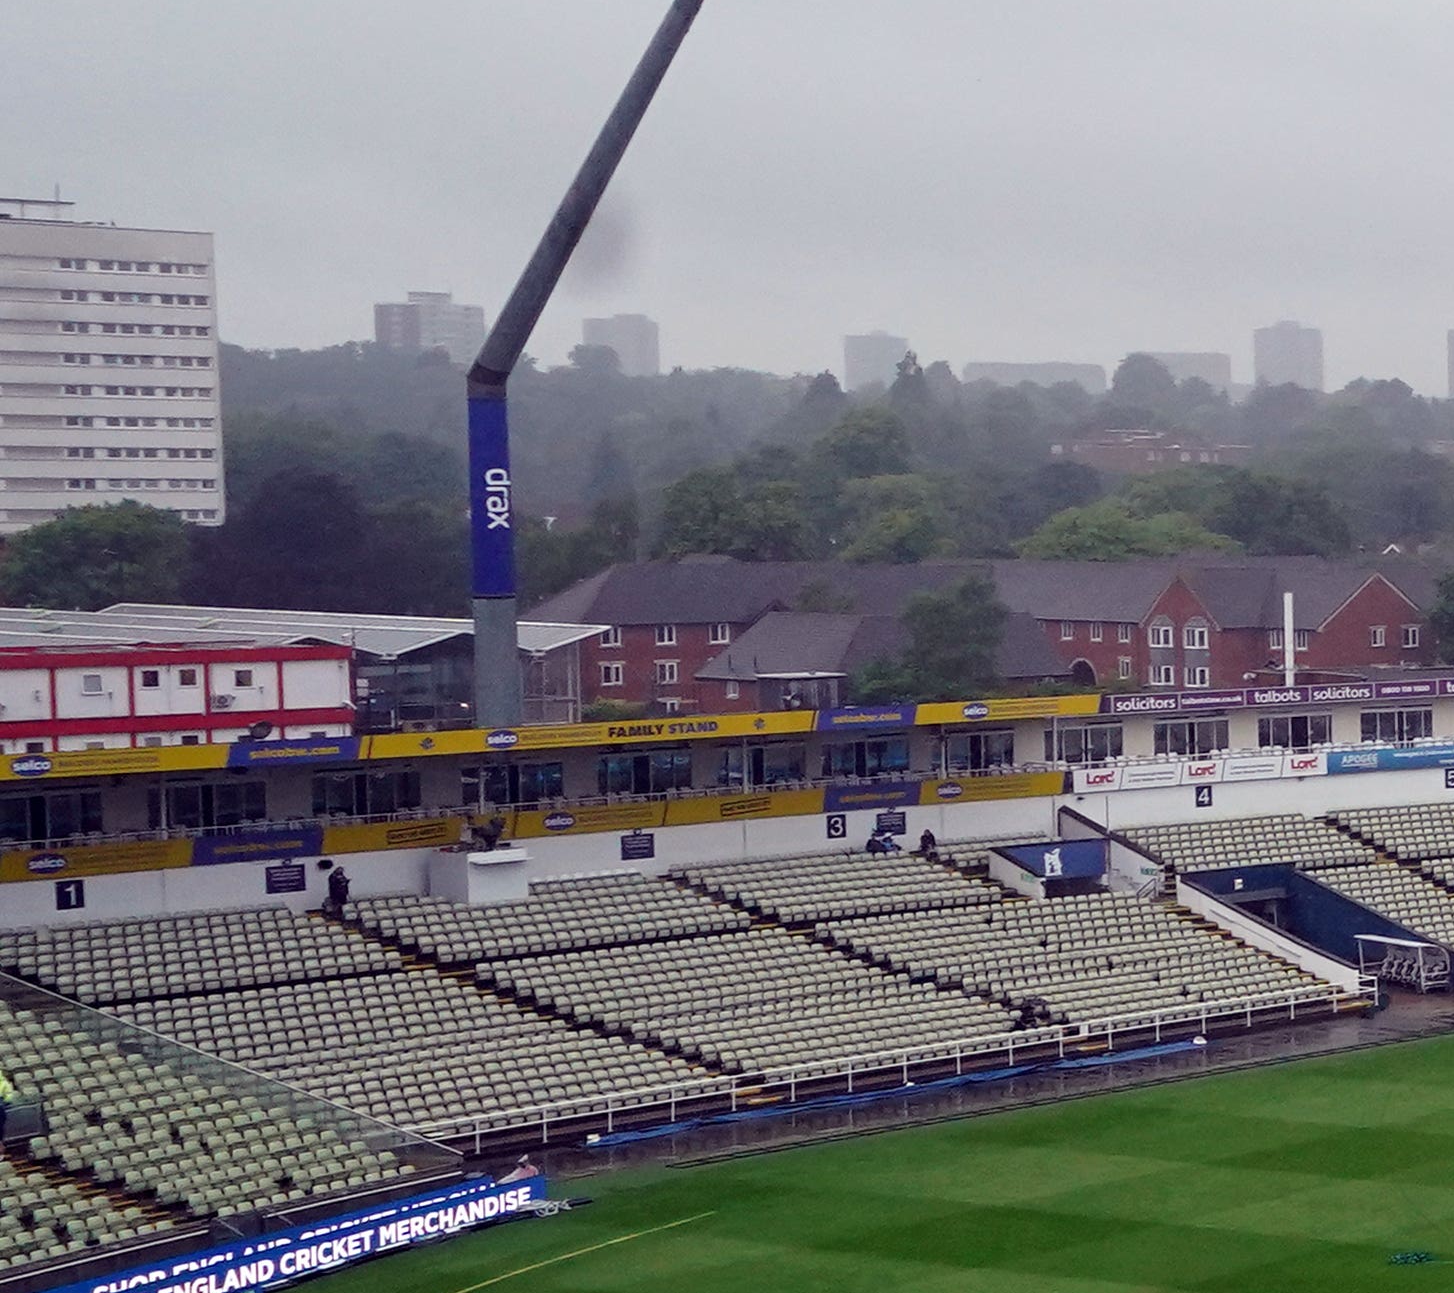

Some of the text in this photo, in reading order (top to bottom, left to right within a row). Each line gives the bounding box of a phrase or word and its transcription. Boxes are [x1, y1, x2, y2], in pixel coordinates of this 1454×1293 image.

[485, 468, 511, 529] drax
[1255, 686, 1370, 704] talbots solicitors
[963, 705, 988, 716] selco
[1116, 697, 1176, 712] solicitors
[608, 724, 664, 738] FAMILY
[668, 721, 718, 734] STAND
[487, 735, 517, 745] selco
[12, 759, 51, 773] selco
[1342, 753, 1378, 764] APOGEE
[1199, 789, 1210, 804] 4
[830, 817, 843, 836] 3
[28, 857, 66, 871] selco
[66, 885, 77, 906] 1
[280, 1230, 372, 1273] CRICKET
[380, 1186, 531, 1247] MERCHANDISE
